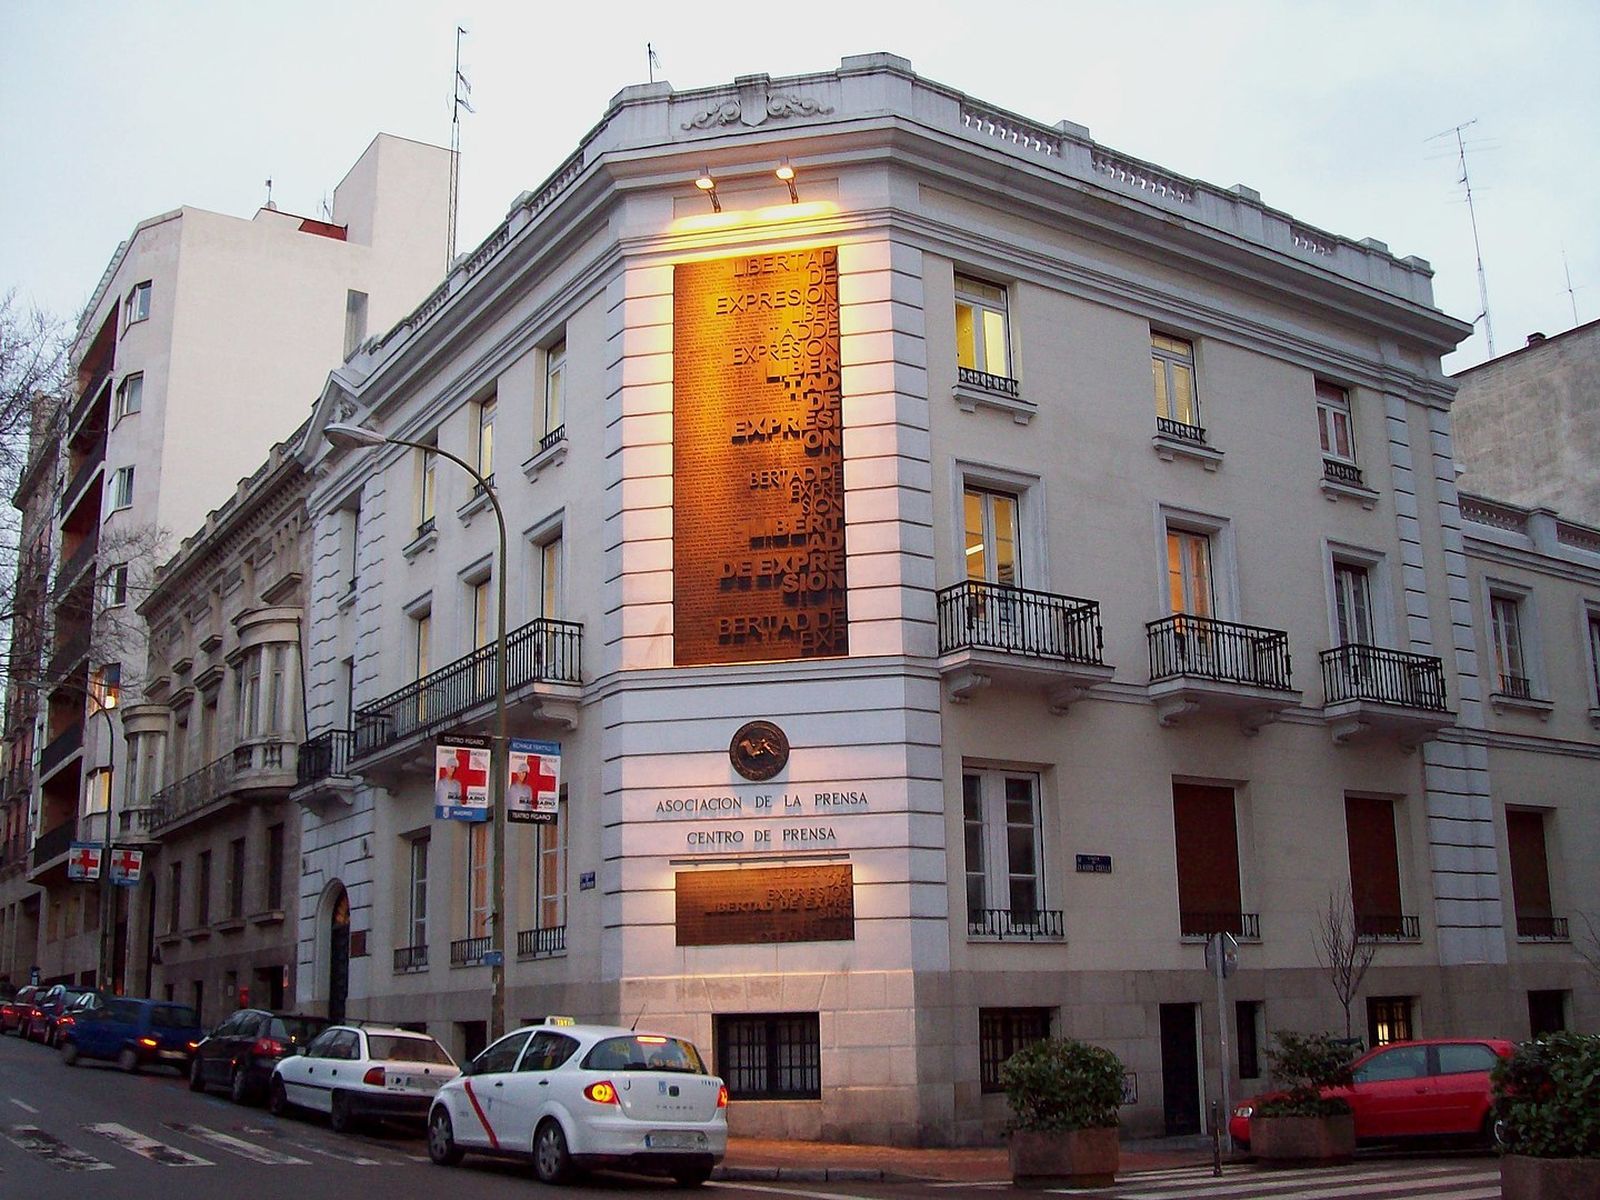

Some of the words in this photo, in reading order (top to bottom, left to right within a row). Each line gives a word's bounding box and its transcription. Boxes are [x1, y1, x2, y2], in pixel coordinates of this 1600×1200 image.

[733, 250, 838, 278] LIBERTAD
[808, 267, 838, 287] DE
[716, 286, 839, 316] EXPRESION
[733, 339, 839, 365] EXPRESION
[805, 390, 841, 412] DE
[804, 430, 841, 450] ON
[782, 570, 845, 594] SION
[656, 797, 742, 812] ASOCIACION
[755, 795, 772, 808] DE
[784, 794, 802, 807] LA
[815, 792, 868, 805] PRENSA
[687, 831, 744, 845] CENTRO
[754, 830, 771, 842] DE
[783, 828, 836, 841] PRENSA
[767, 886, 851, 901] EXPRESION
